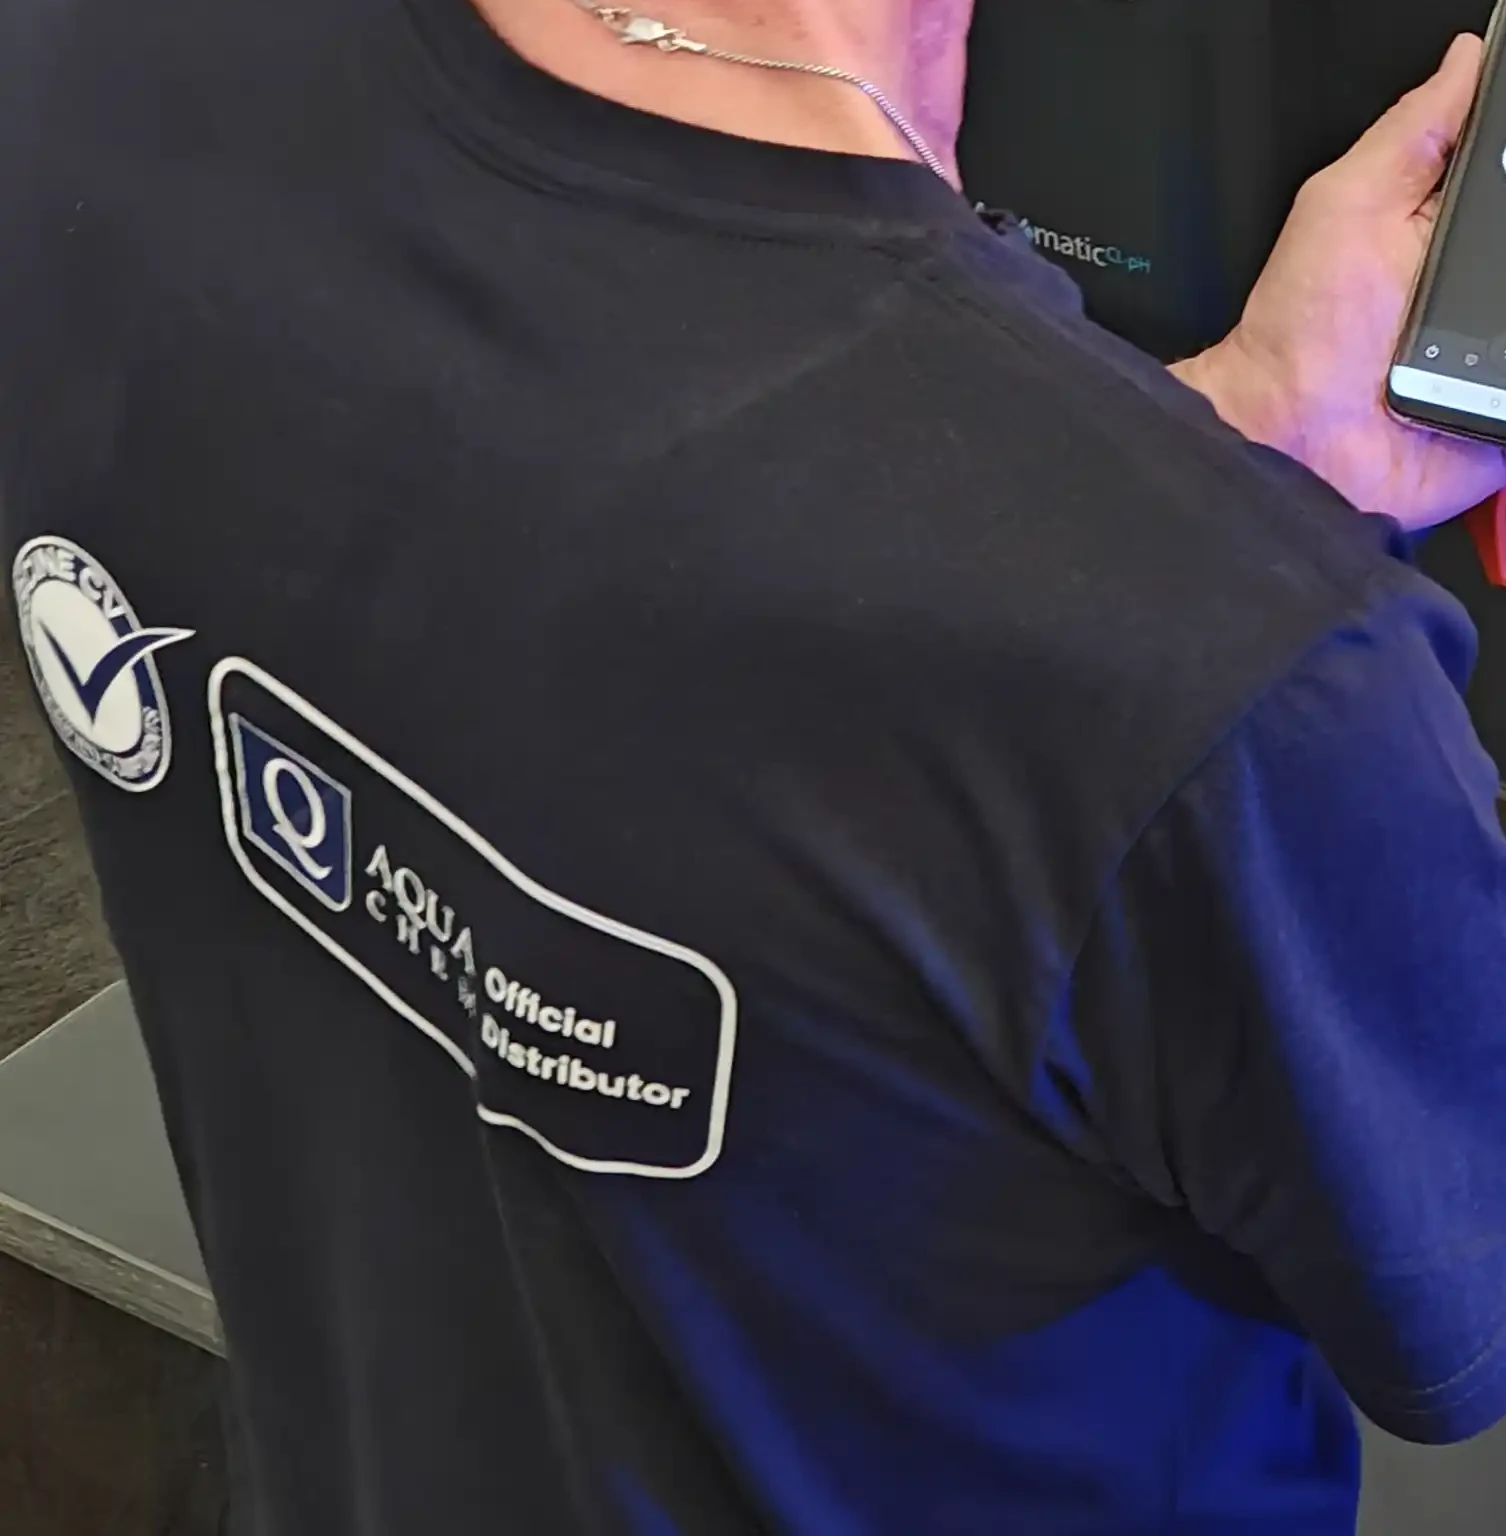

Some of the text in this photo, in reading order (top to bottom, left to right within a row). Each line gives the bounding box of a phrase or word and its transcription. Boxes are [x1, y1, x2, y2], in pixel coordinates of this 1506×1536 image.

[263, 758, 333, 880] Q
[365, 844, 478, 976] AQUA
[481, 1013, 690, 1109] Distributor
[485, 967, 616, 1048] Official
